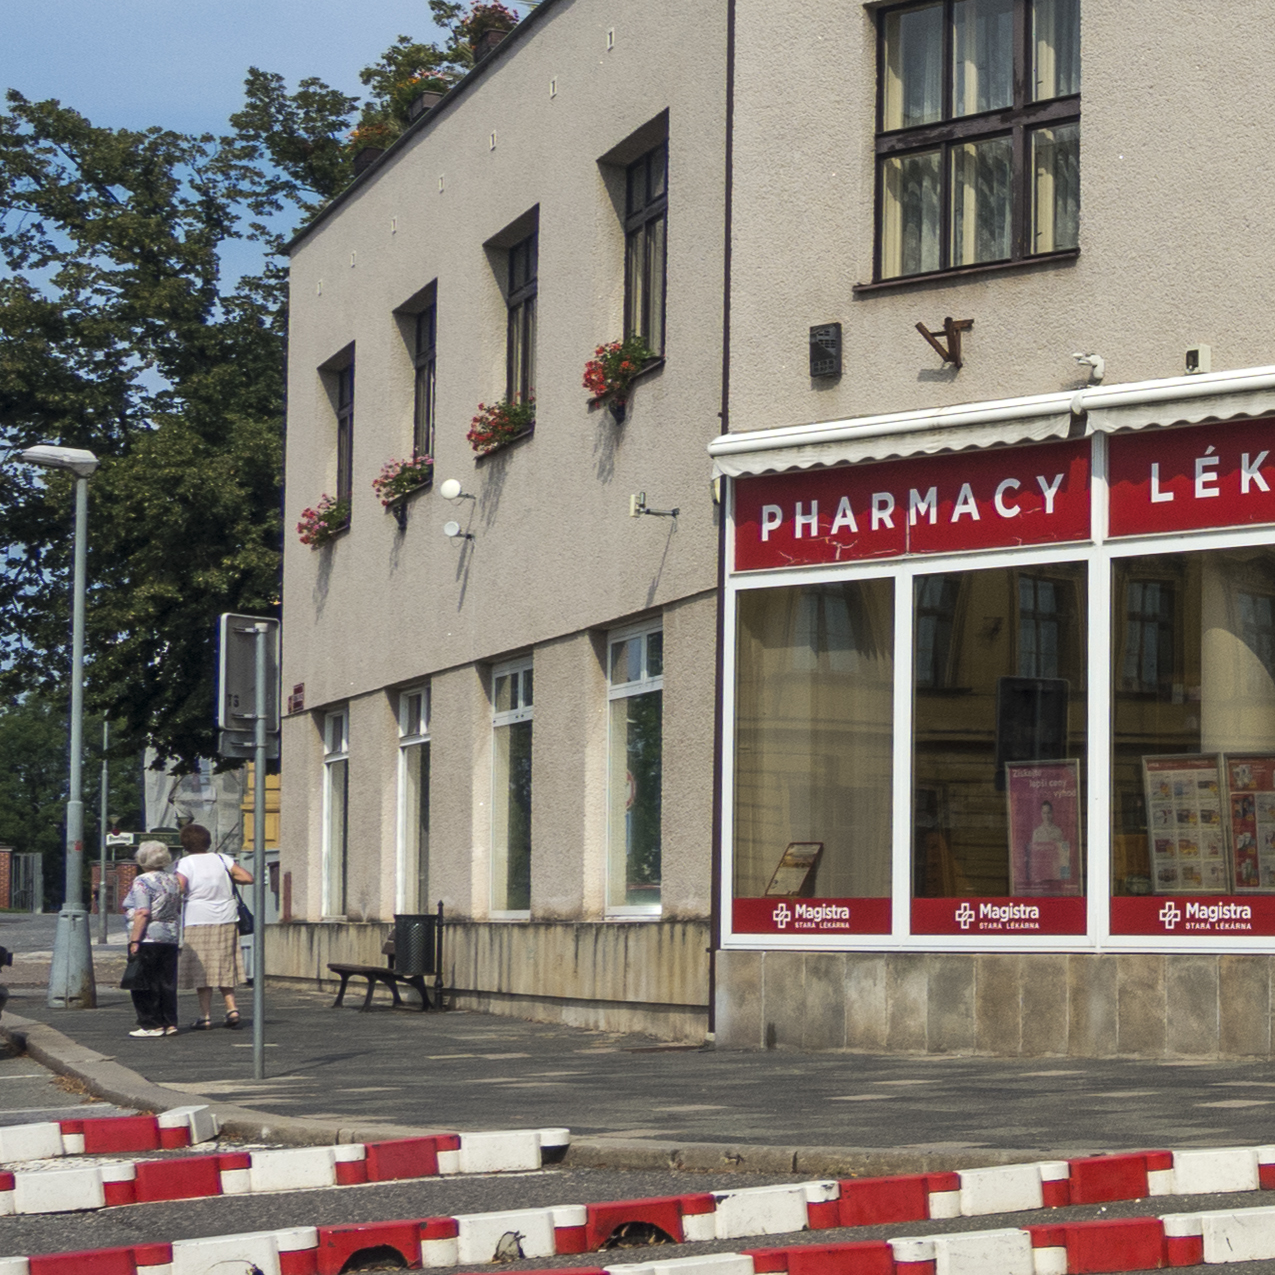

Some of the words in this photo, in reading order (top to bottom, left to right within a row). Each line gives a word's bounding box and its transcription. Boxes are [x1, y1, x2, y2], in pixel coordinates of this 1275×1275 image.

[761, 473, 1064, 542] PHARMACY
[794, 903, 850, 922] Magistra
[979, 902, 1039, 922] Magistra
[1185, 902, 1251, 922] Magistra
